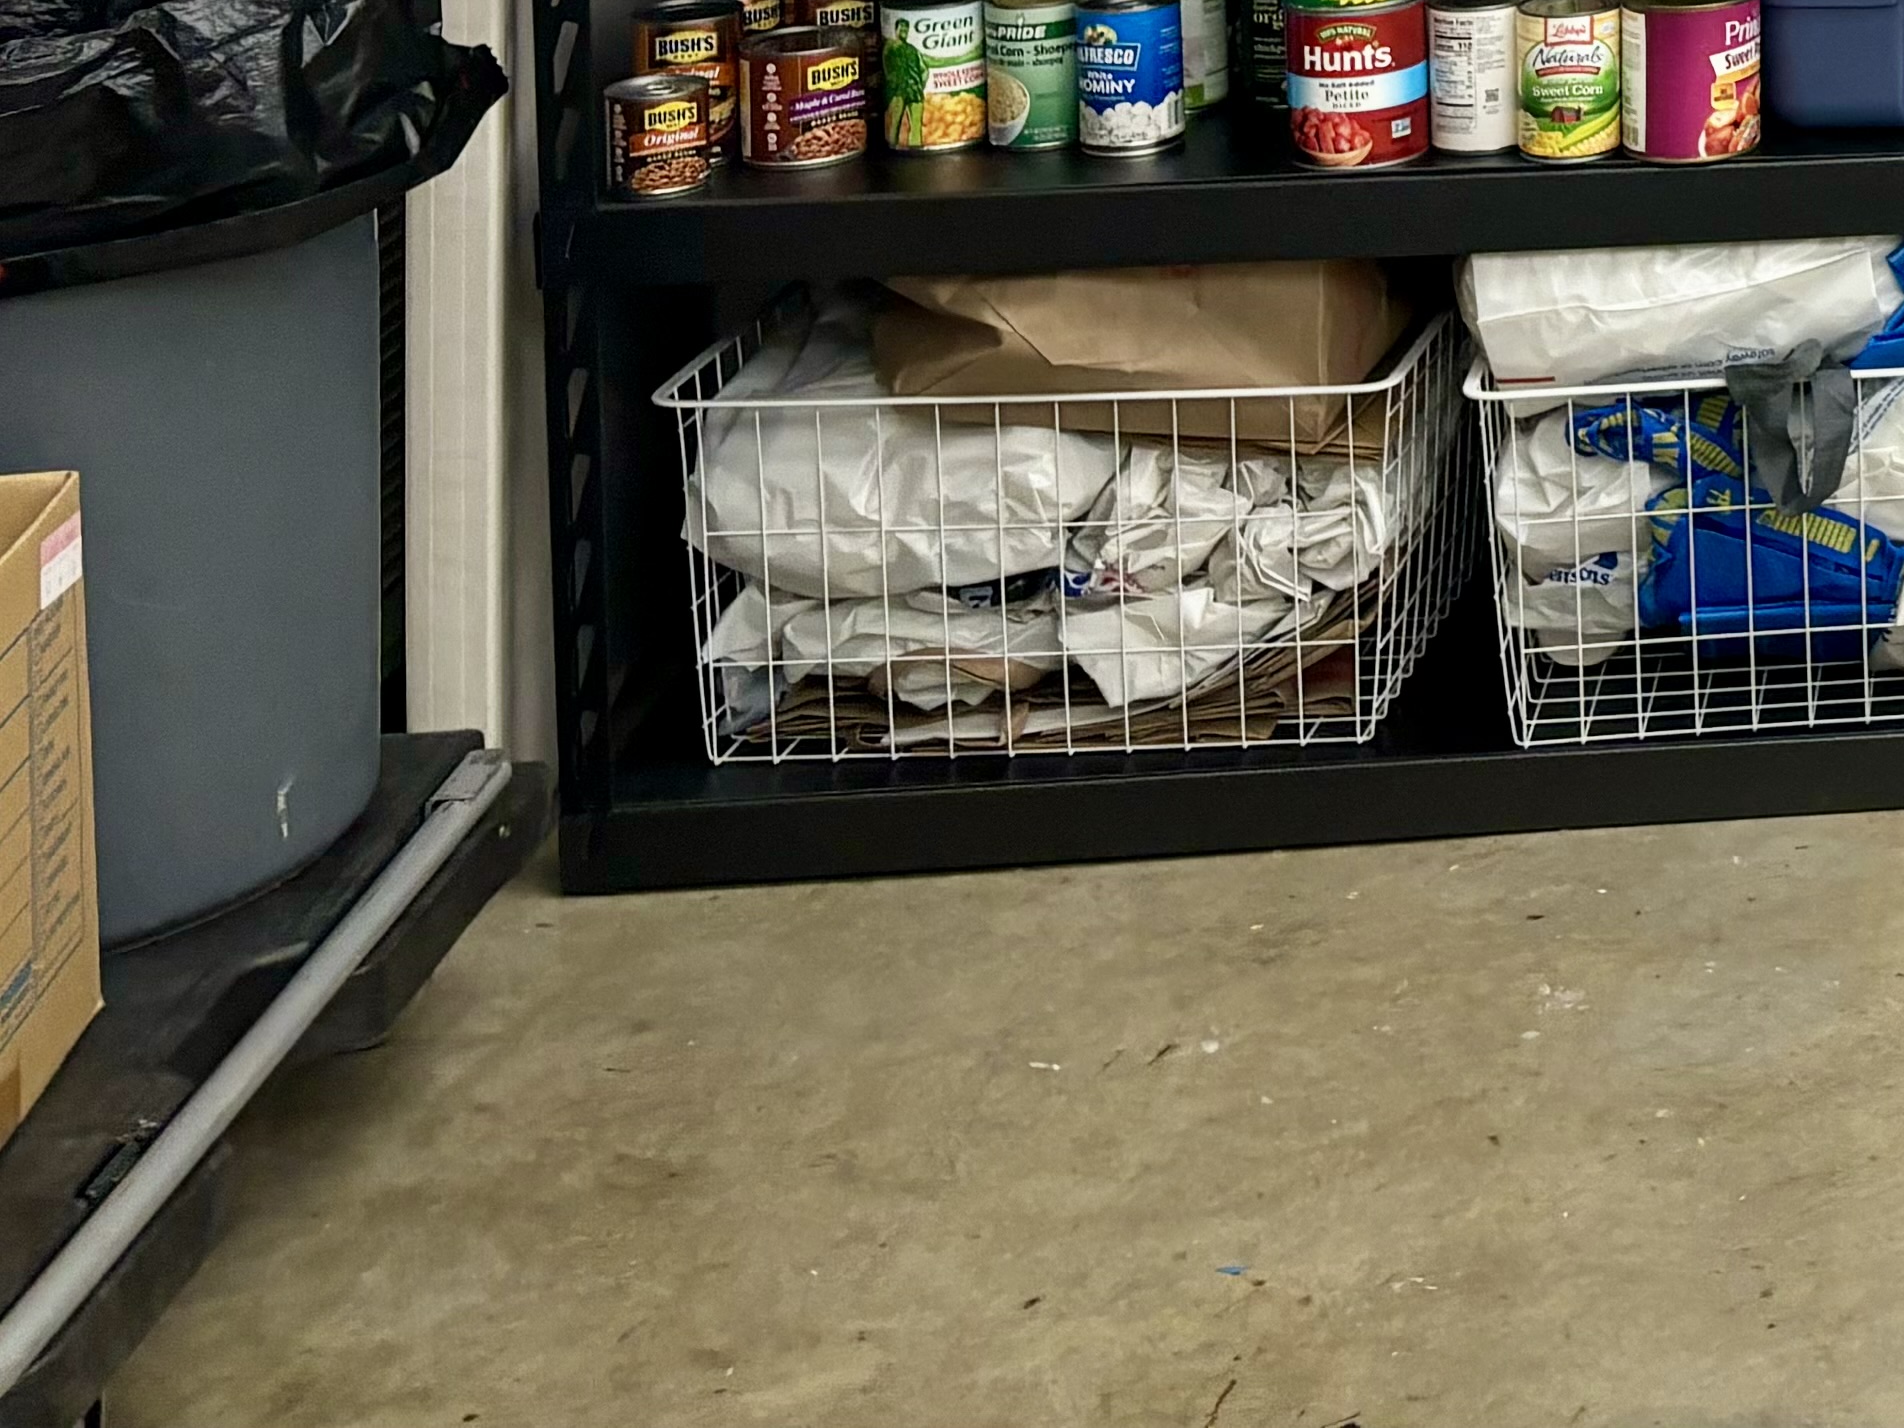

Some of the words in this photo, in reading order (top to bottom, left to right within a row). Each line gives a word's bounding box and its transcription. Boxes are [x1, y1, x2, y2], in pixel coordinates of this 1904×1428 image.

[819, 4, 873, 26] BUSH'S
[915, 16, 974, 34] Green
[997, 23, 1047, 40] PRIDE
[1552, 20, 1586, 37] Libby's
[657, 36, 714, 56] BUSH'S
[922, 31, 974, 51] Giant
[1304, 44, 1392, 72] Hunt's
[1533, 45, 1603, 66] Naturals
[1725, 47, 1751, 69] Sweet
[811, 61, 857, 85] BUSH'S
[1325, 88, 1369, 102] Petite
[1533, 85, 1570, 96] Sweet
[1572, 84, 1604, 95] Corn
[648, 105, 695, 126] BUSH'S
[644, 129, 699, 146] Original
